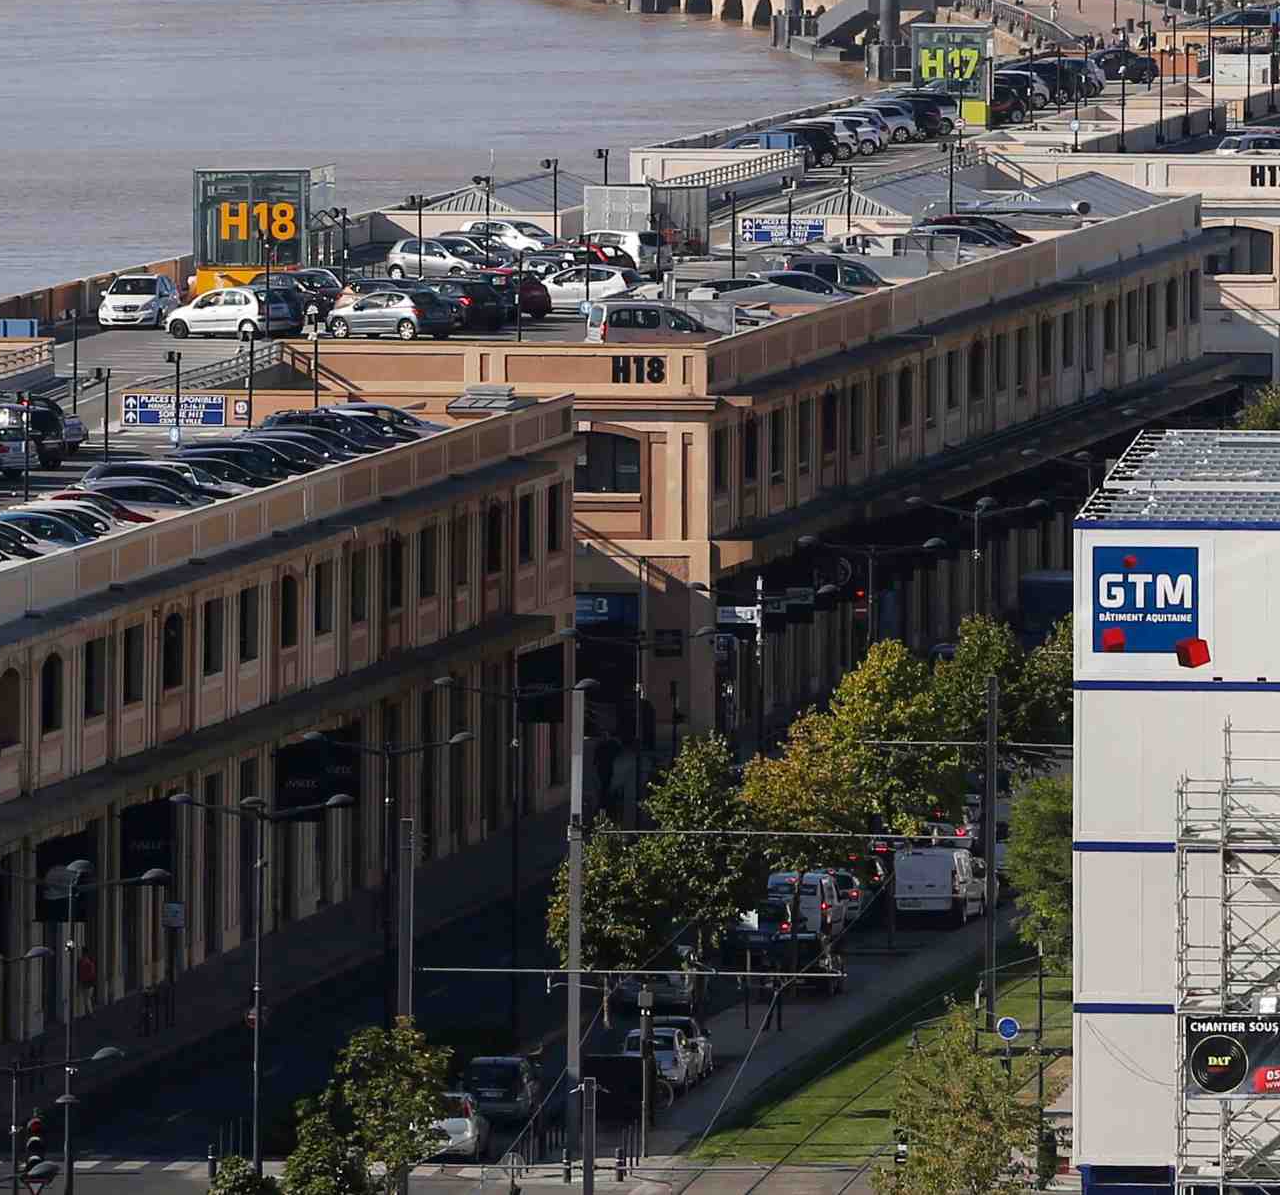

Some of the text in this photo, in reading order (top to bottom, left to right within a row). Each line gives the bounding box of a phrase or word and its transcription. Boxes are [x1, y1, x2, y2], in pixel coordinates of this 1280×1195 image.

[921, 49, 978, 79] H17
[221, 202, 296, 240] H18
[612, 356, 665, 383] H18
[140, 396, 168, 404] PLACES
[1099, 573, 1193, 608] GTM
[1099, 611, 1193, 623] BÂTIMENT AQUITAINE
[1190, 1021, 1246, 1033] CHANTIER
[1249, 1021, 1278, 1033] SOUS
[1207, 1055, 1231, 1066] DAT
[1266, 1070, 1279, 1080] 05
